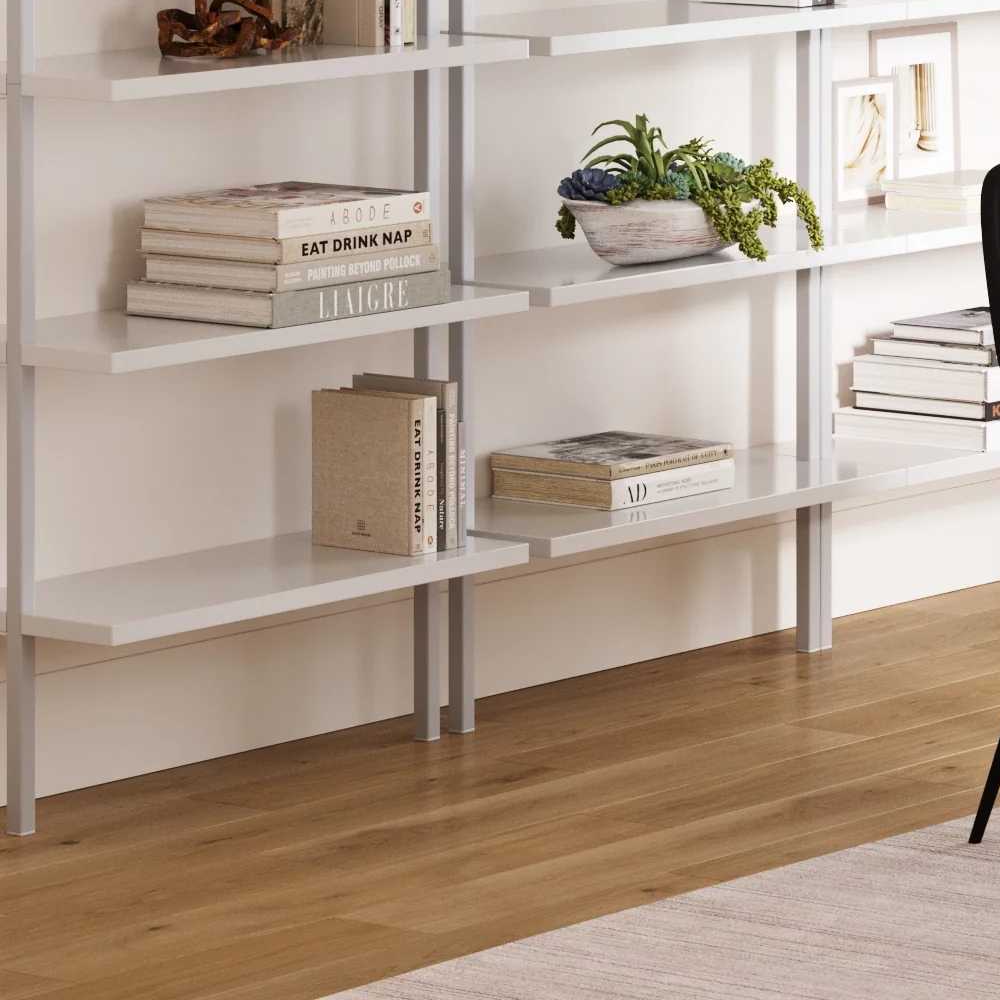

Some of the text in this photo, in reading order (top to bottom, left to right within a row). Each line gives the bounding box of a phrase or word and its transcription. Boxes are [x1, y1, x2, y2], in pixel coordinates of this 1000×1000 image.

[330, 203, 390, 225] ABODE
[302, 240, 328, 256] EAT
[333, 233, 379, 252] DRINK
[382, 229, 412, 245] NAP
[307, 264, 346, 281] PAINTING
[348, 259, 381, 276] BEYOND
[383, 254, 421, 271] POLLOCK
[319, 279, 409, 319] LIAIGRE
[448, 413, 456, 453] PAINTING
[426, 449, 435, 512] ABODE
[448, 455, 456, 489] BEYOND
[448, 491, 456, 530] POLLOCK
[622, 482, 648, 505] AD
